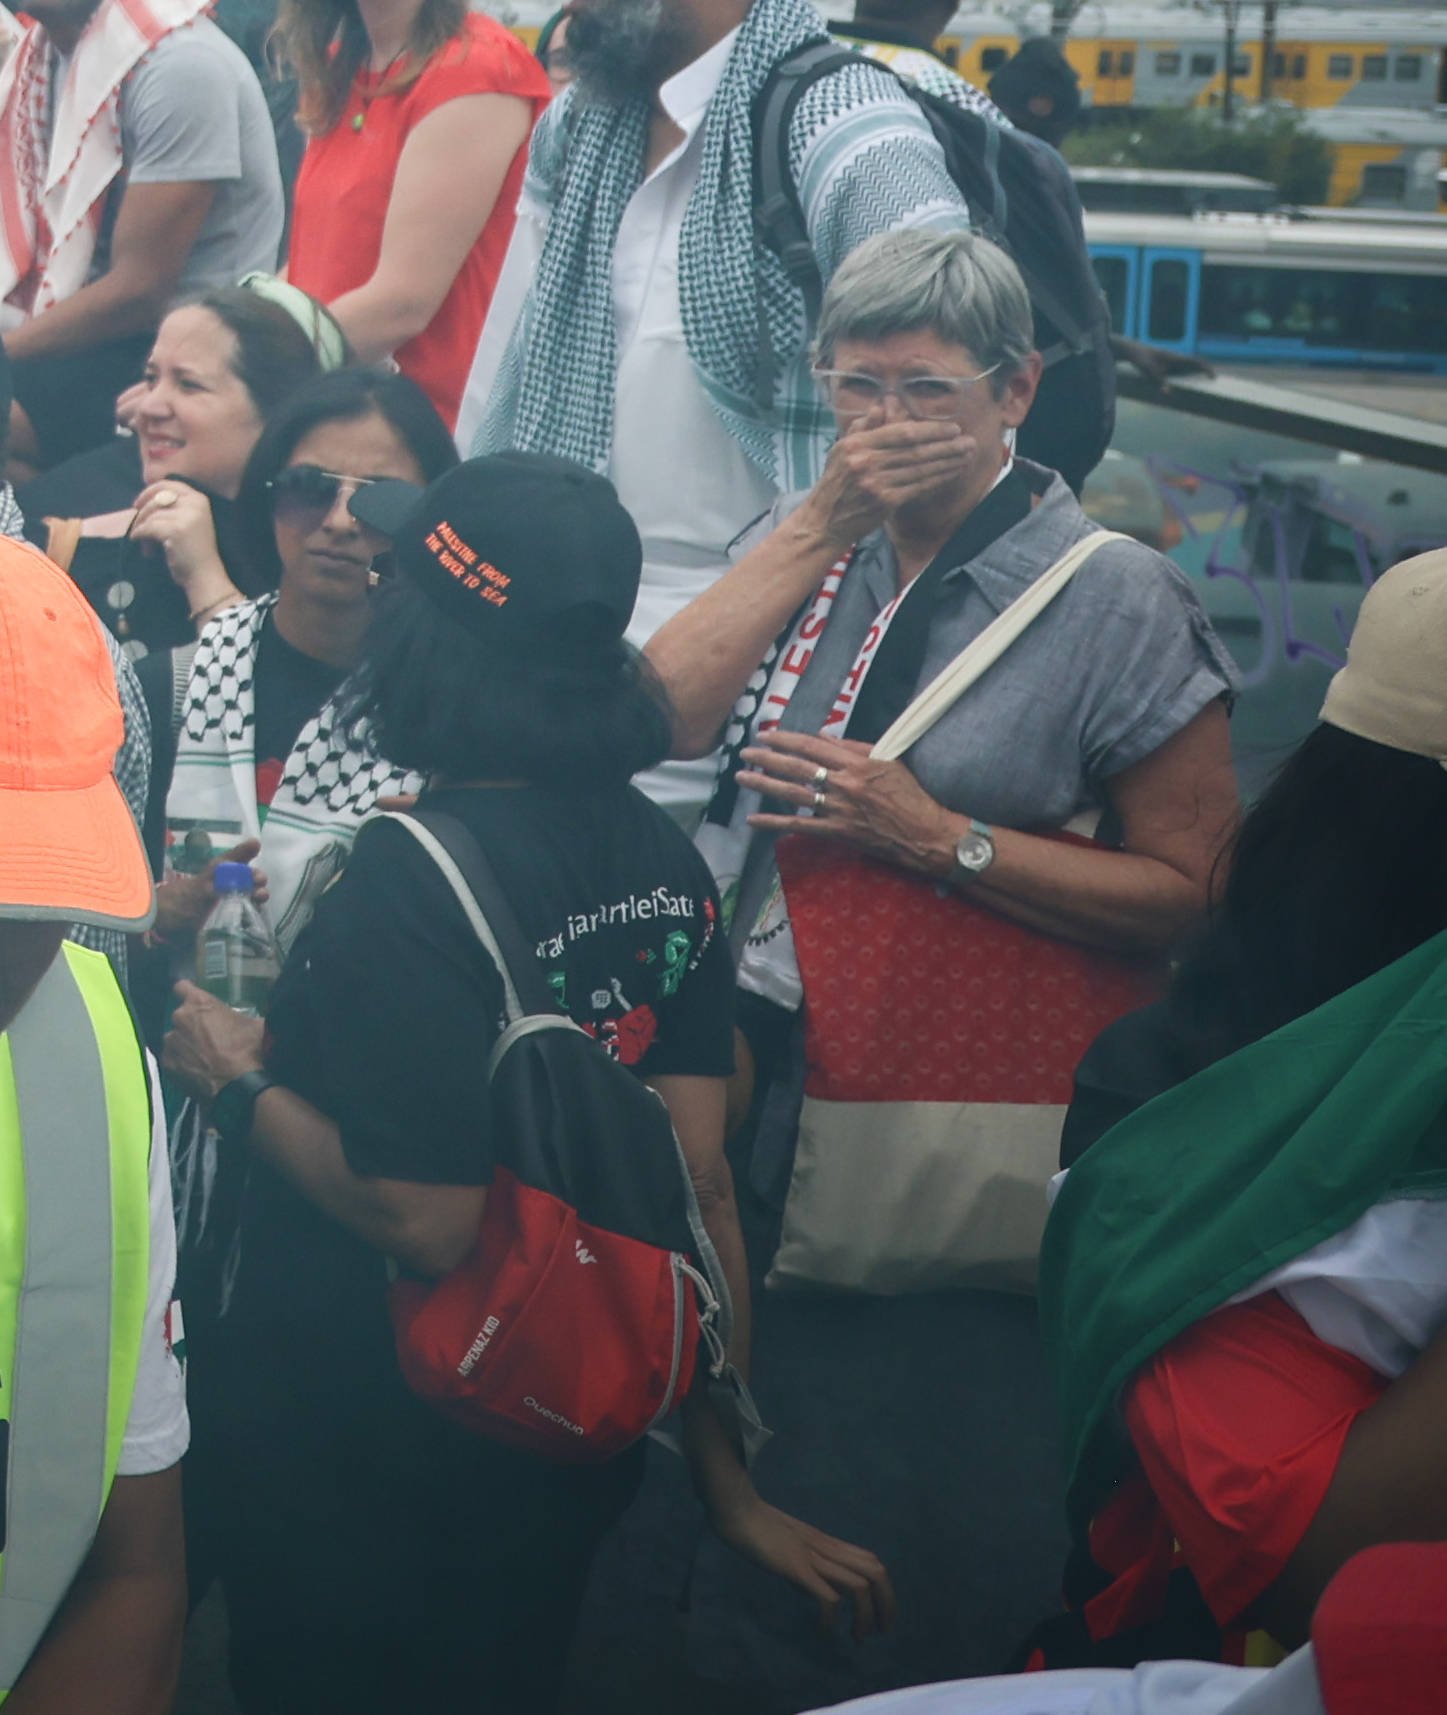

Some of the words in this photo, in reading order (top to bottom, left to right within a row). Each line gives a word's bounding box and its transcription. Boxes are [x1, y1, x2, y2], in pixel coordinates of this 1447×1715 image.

[424, 532, 444, 554] THE
[438, 549, 466, 579] RIVER
[462, 572, 481, 590] TO
[480, 585, 509, 608] SEA
[436, 520, 478, 565] PALESTINE
[477, 561, 511, 589] FROM
[523, 1395, 585, 1436] Quechua
